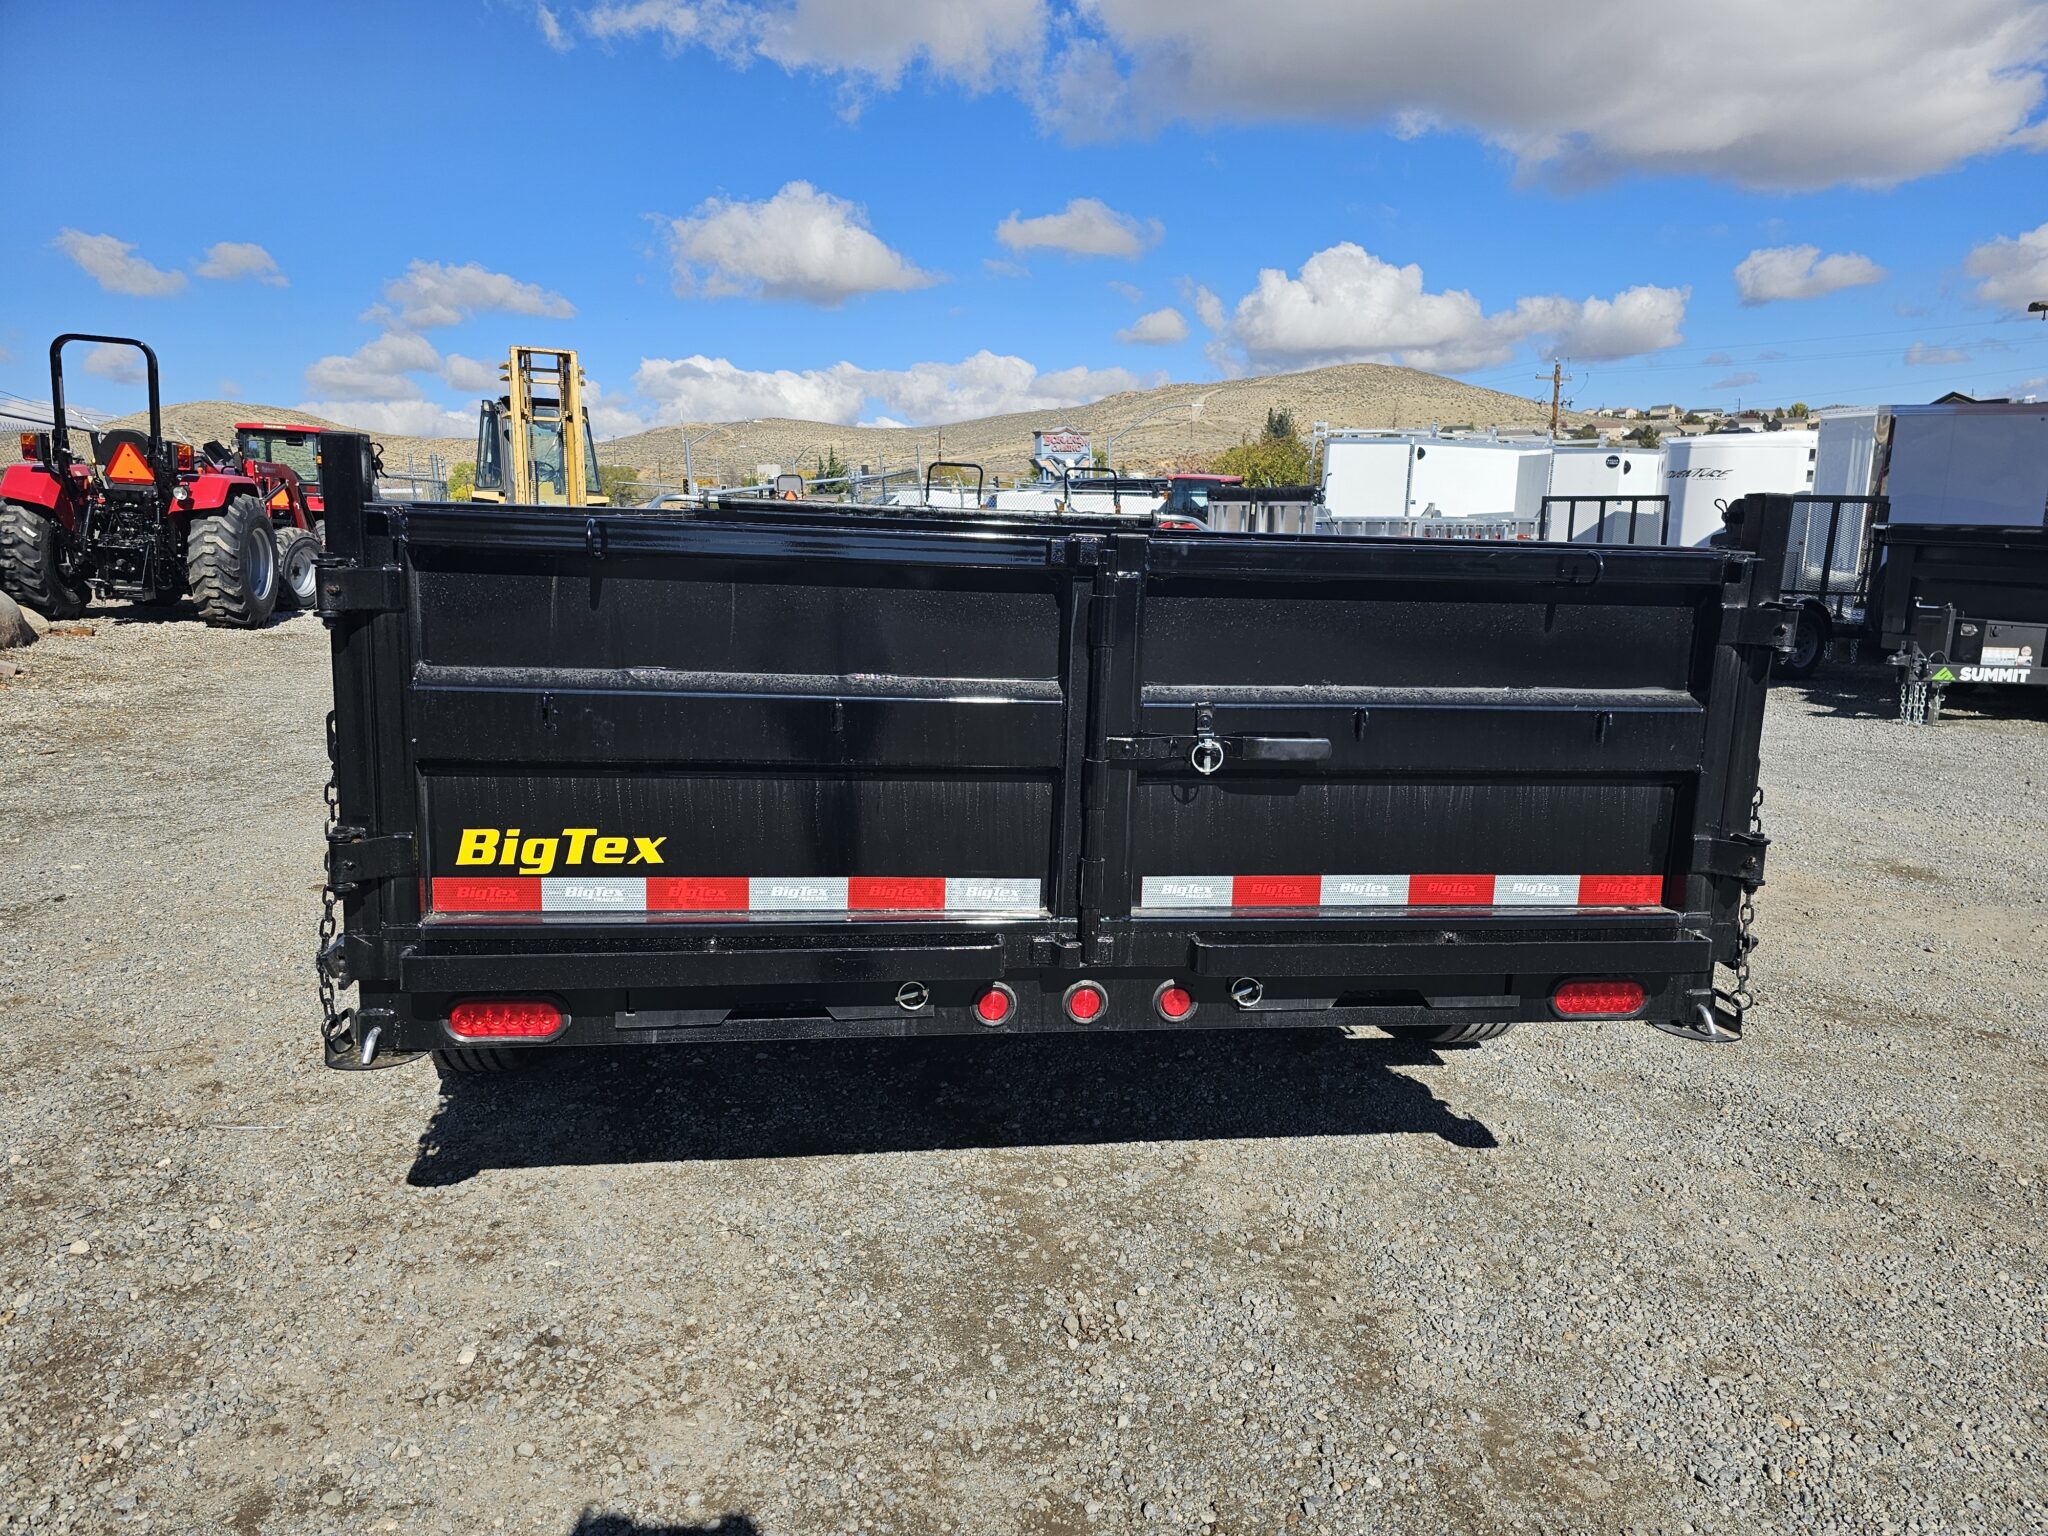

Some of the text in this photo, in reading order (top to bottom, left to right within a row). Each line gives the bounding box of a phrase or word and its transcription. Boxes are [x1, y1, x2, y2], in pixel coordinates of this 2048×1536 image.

[1959, 667, 2031, 683] SUMMIT
[455, 828, 667, 875] BigTex
[456, 886, 519, 899] BigTex
[565, 886, 625, 898] BigTex
[771, 886, 828, 899] BigTex
[868, 886, 926, 898] BigTex
[965, 886, 1019, 899] BigTex
[1161, 884, 1212, 896] BigTex
[1250, 884, 1303, 895] BigTex
[1339, 883, 1389, 894] BigTex
[1427, 883, 1477, 894] BigTex
[1512, 883, 1560, 894] BigTex
